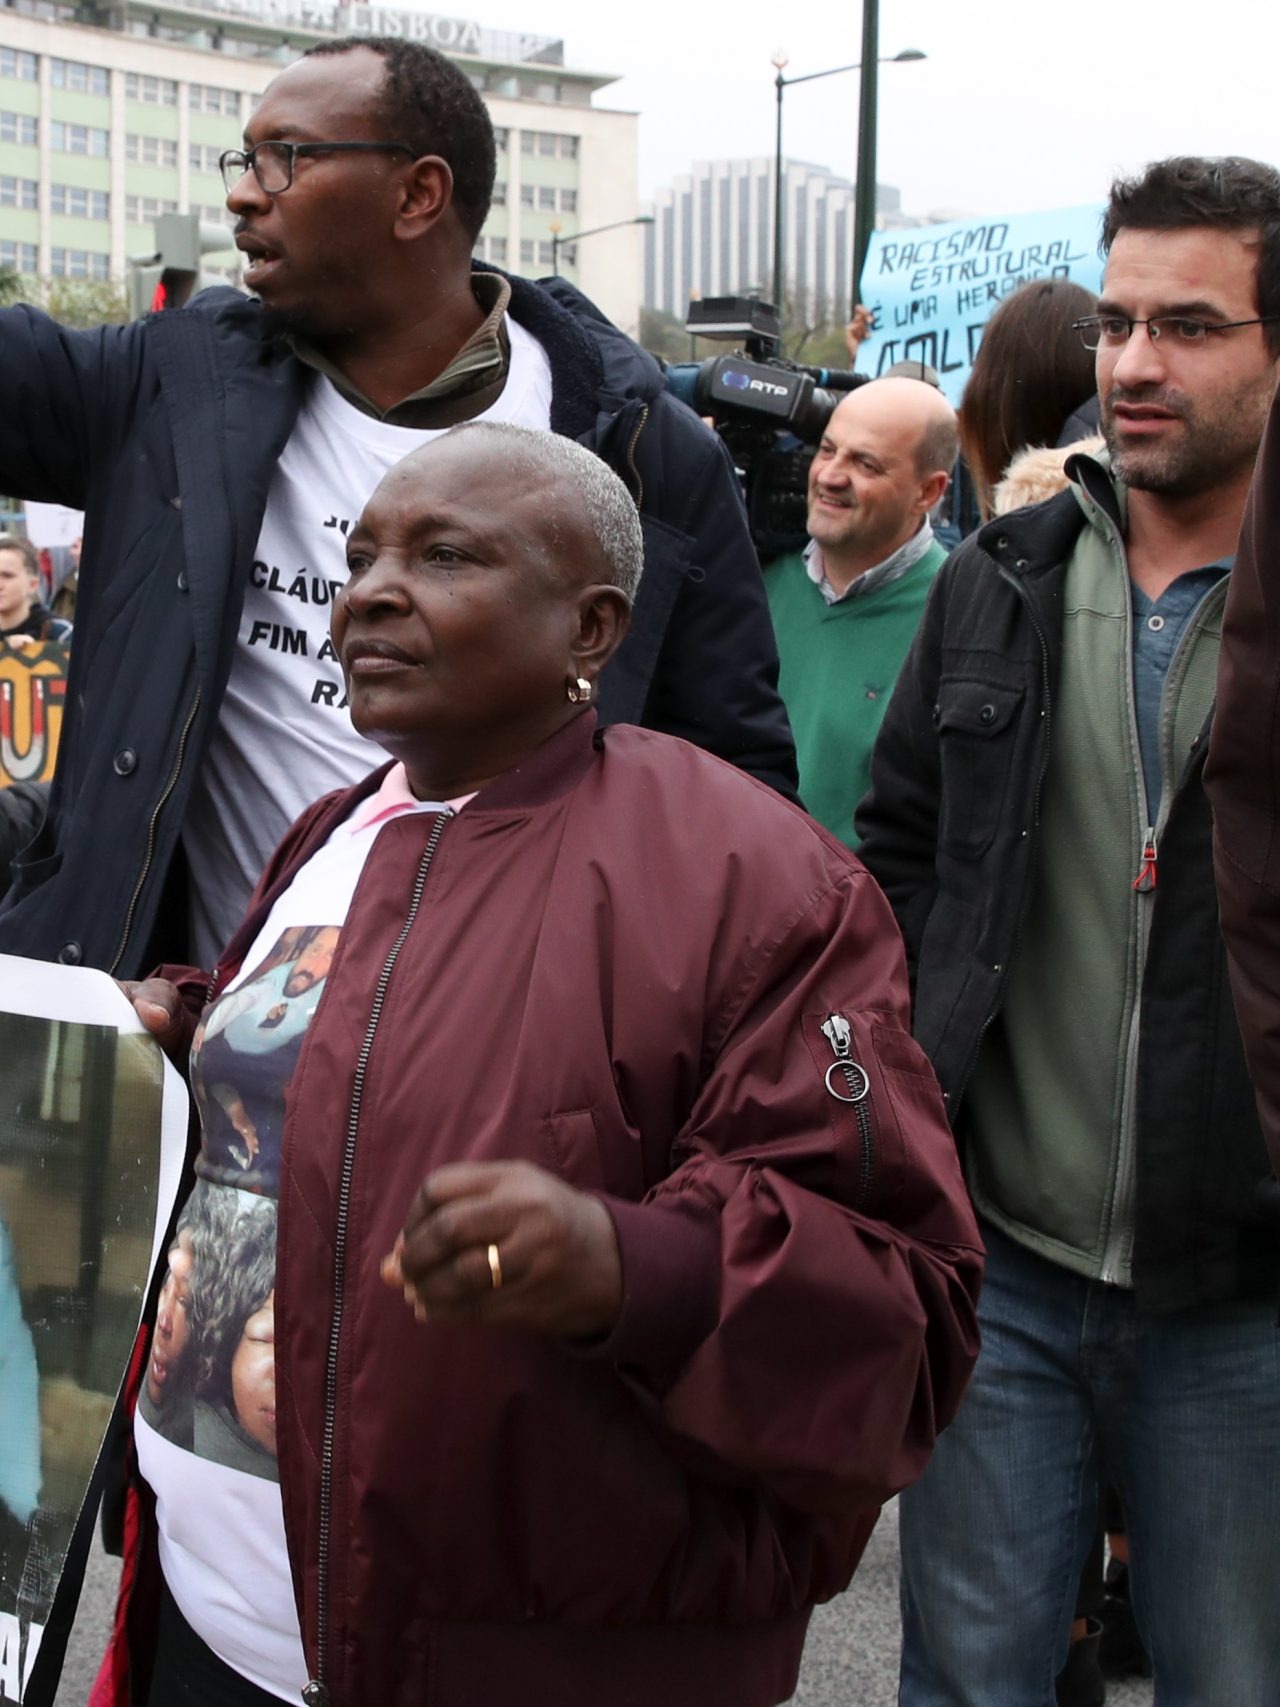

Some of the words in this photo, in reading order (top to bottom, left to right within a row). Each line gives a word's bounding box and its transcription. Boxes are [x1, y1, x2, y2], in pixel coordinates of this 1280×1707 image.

[348, 6, 482, 45] LISBOA
[879, 223, 1009, 275] RACISMO
[910, 240, 1088, 292] ESTRUTURAL
[750, 379, 788, 397] RTP
[247, 620, 308, 656] FIM
